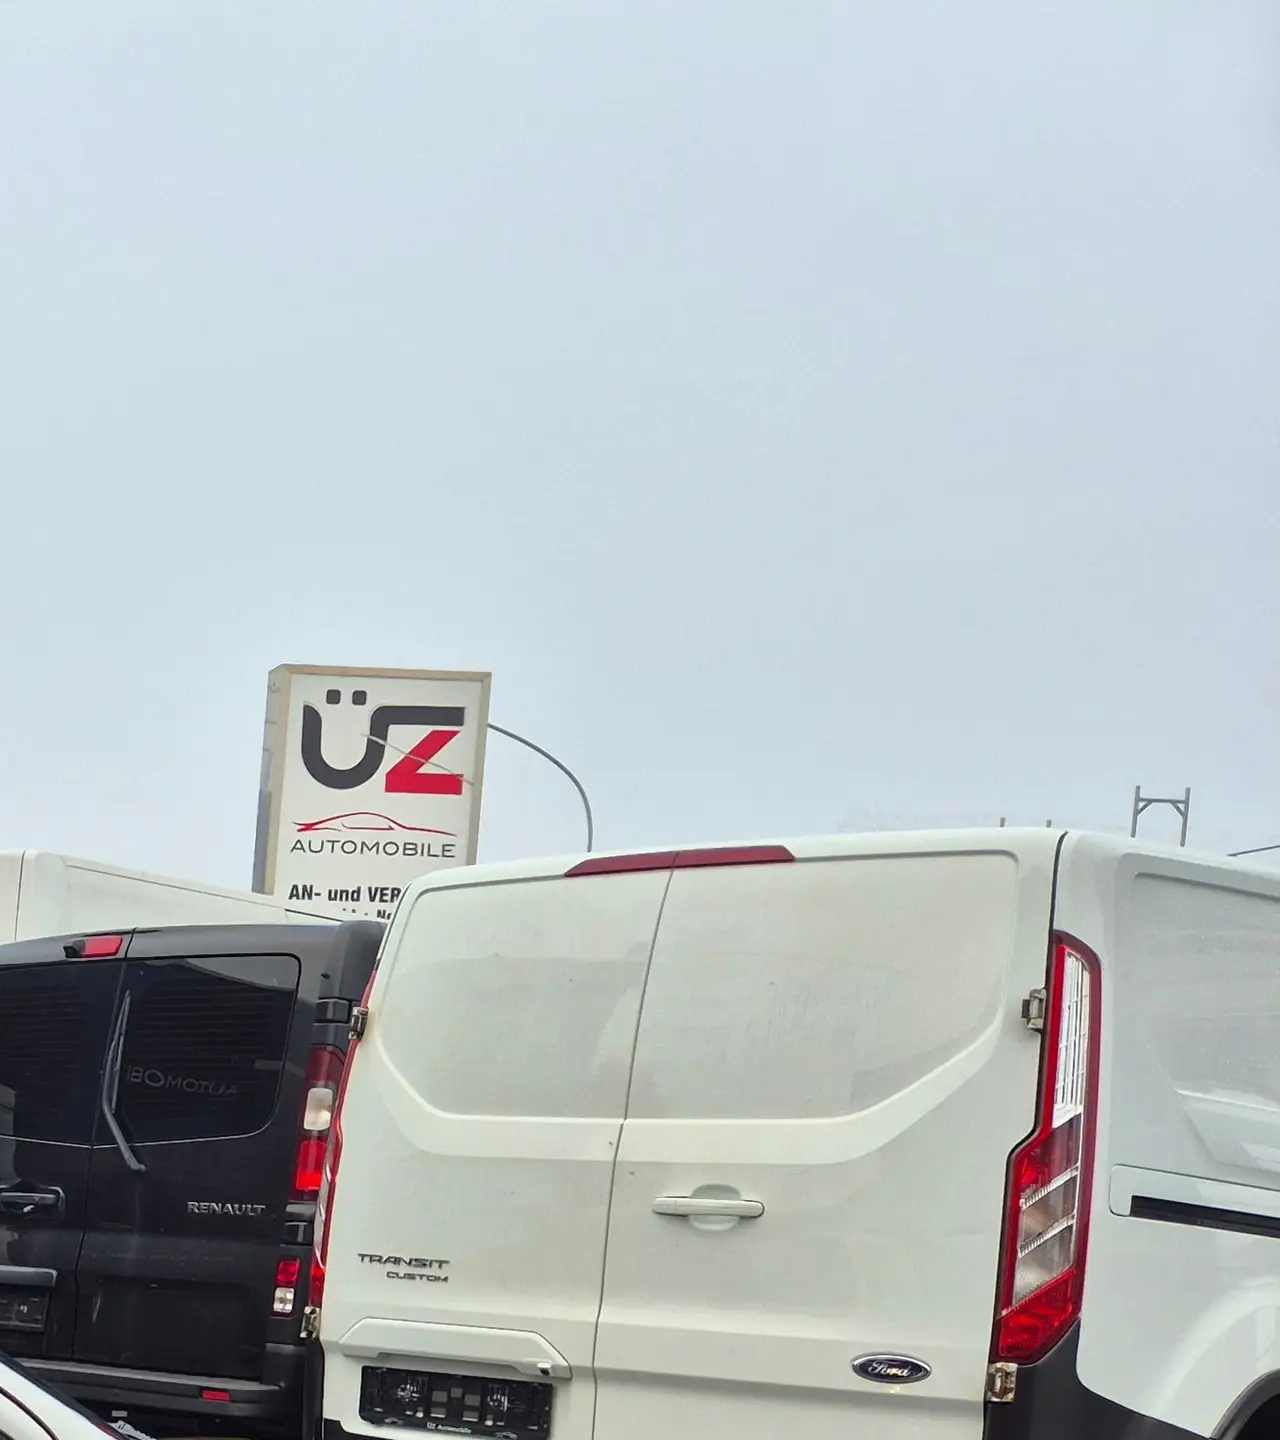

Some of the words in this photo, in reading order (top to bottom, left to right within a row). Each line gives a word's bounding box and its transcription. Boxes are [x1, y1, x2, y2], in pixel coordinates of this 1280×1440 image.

[300, 688, 465, 796] ÜZ
[289, 839, 457, 859] AUTOMOBILE
[287, 883, 322, 901] AN-
[327, 885, 362, 903] und
[186, 1201, 267, 1216] RENAULT
[356, 1253, 451, 1270] TRANSIT
[386, 1271, 450, 1283] CUSTOM
[867, 1359, 912, 1378] Ford
